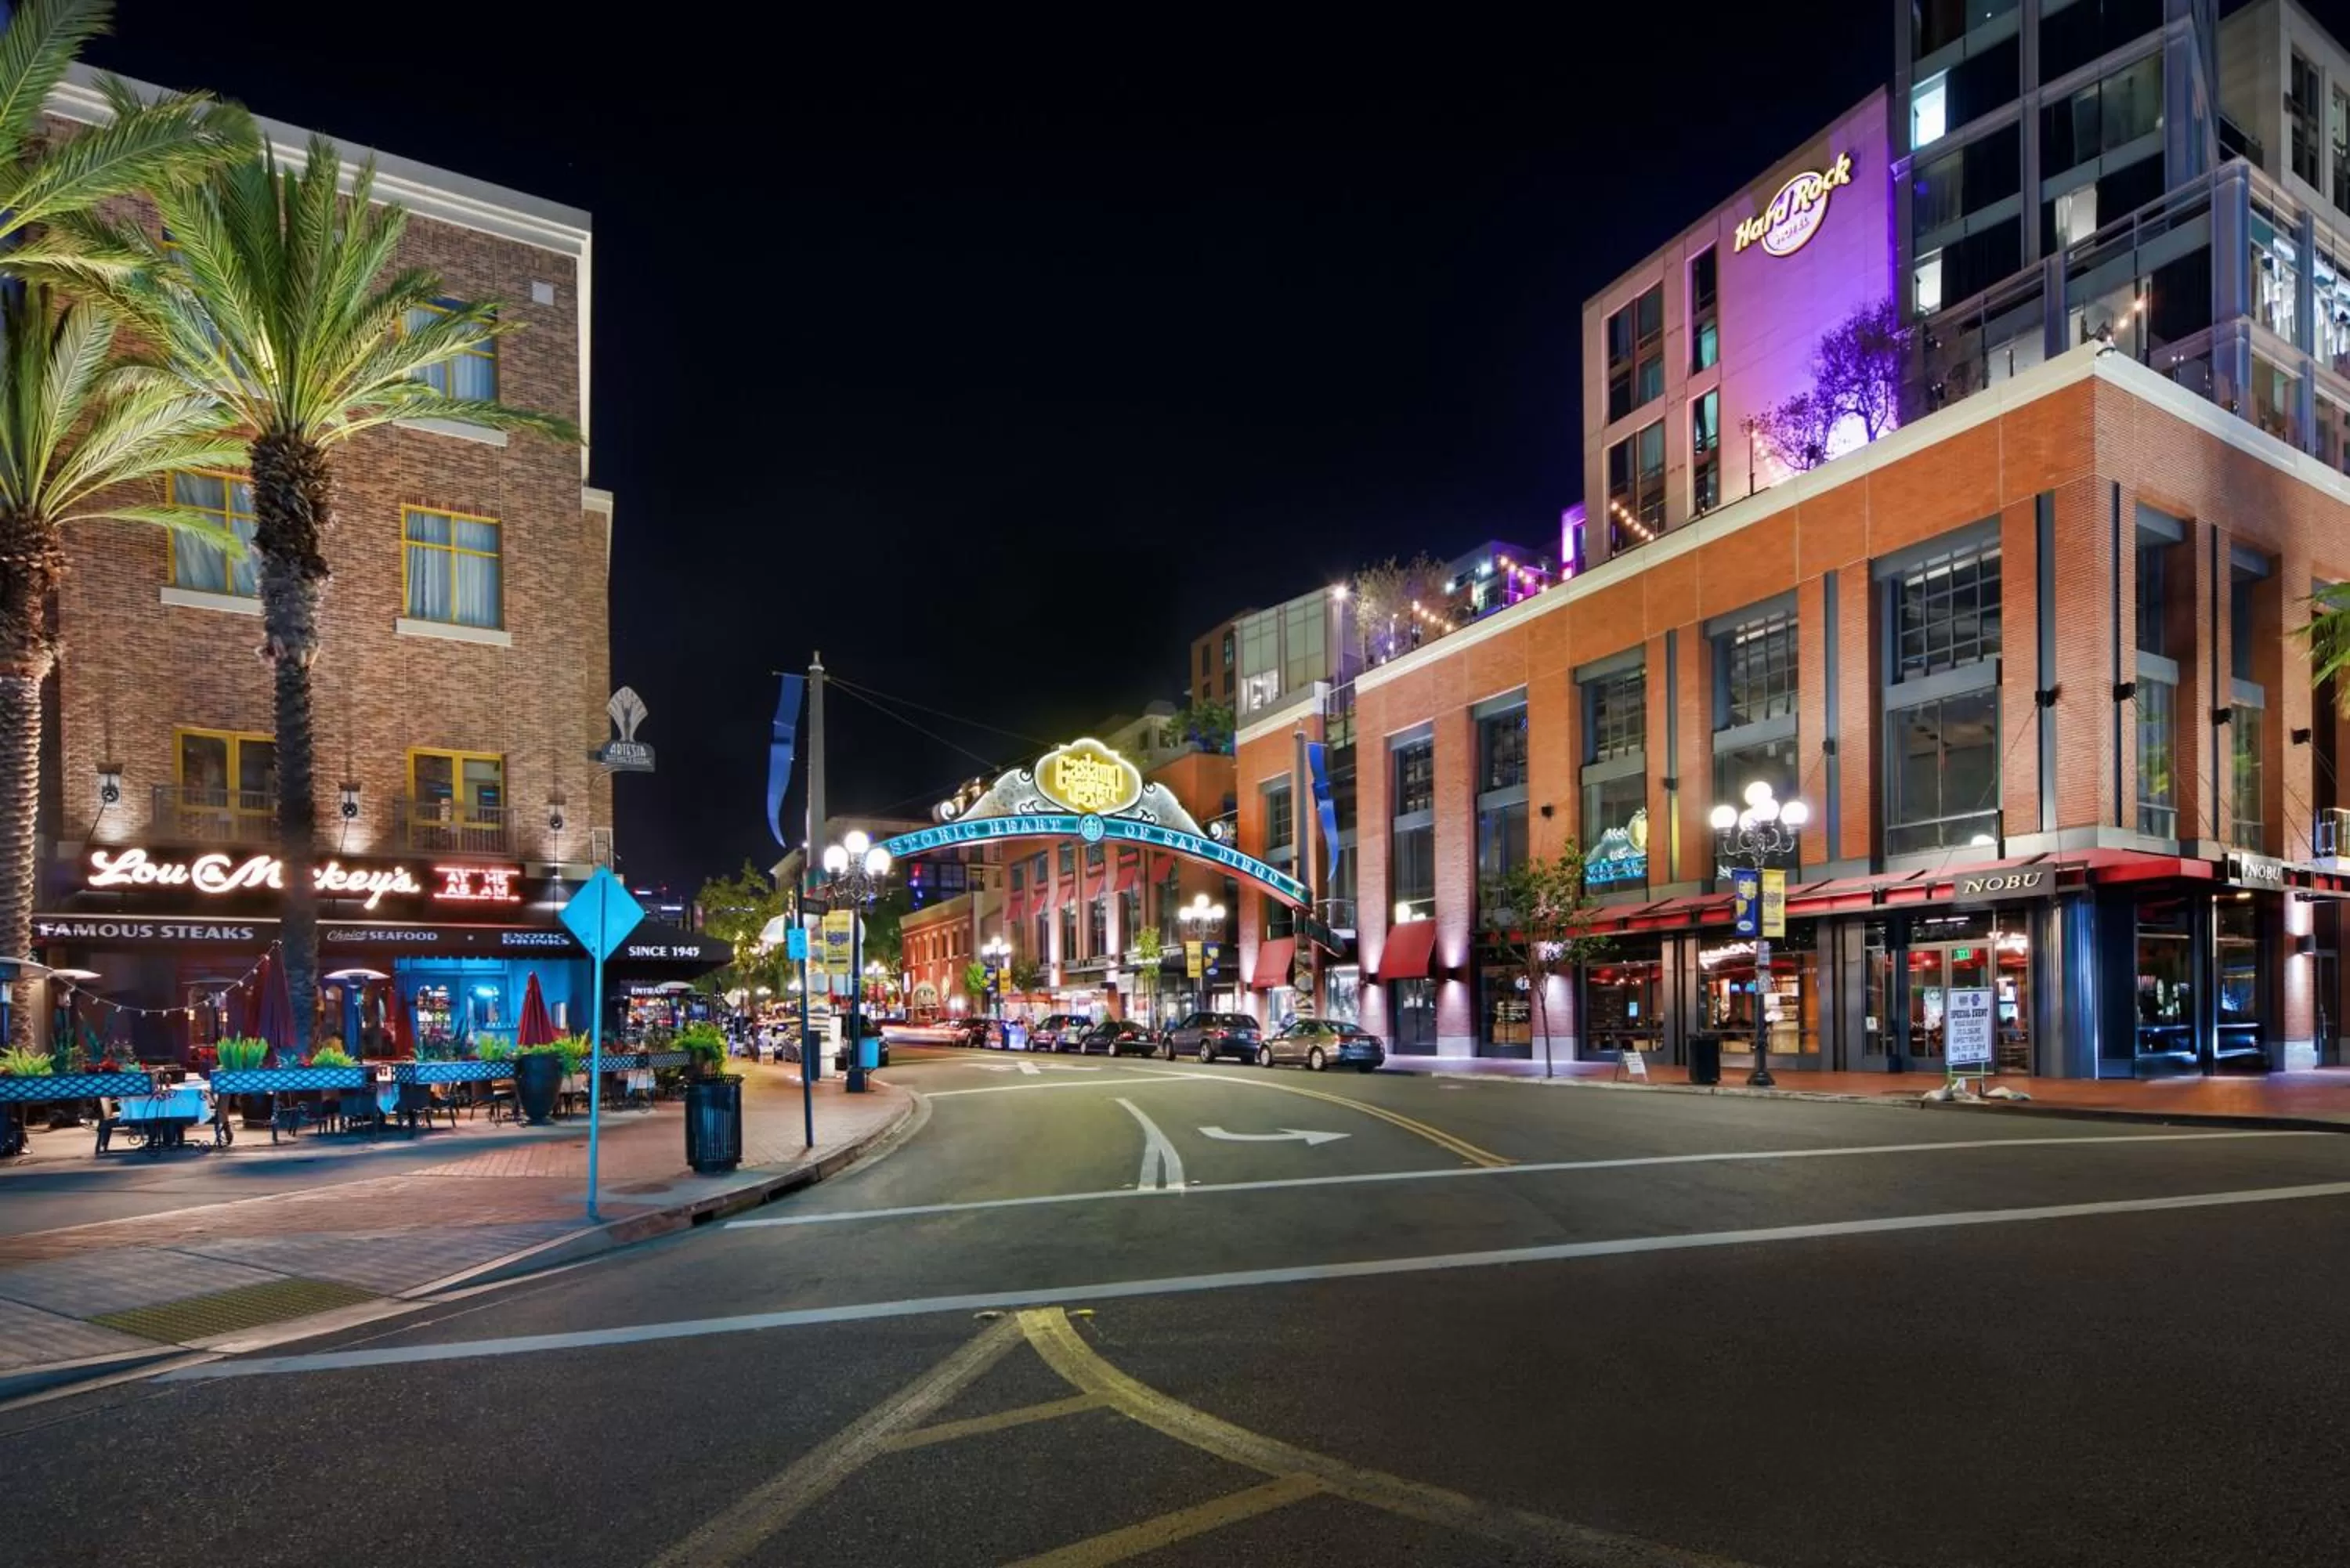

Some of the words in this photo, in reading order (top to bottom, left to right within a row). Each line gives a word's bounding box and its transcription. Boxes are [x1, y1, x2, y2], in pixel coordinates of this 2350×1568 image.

[1734, 187, 1792, 252] Hard
[1794, 152, 1852, 214] Rock
[889, 825, 978, 856] STORIC
[989, 818, 1062, 834] HEART
[1124, 824, 1152, 838] OF
[1163, 831, 1204, 854] SAN
[1217, 849, 1280, 885] DIEGO
[87, 848, 190, 887] Lou
[2248, 863, 2280, 880] NOBU
[1963, 871, 2044, 894] NOBU
[38, 921, 154, 938] FAMOUS
[159, 924, 255, 940] STEAKS
[368, 930, 439, 941] SEAFOOD
[628, 945, 667, 957] SINCE
